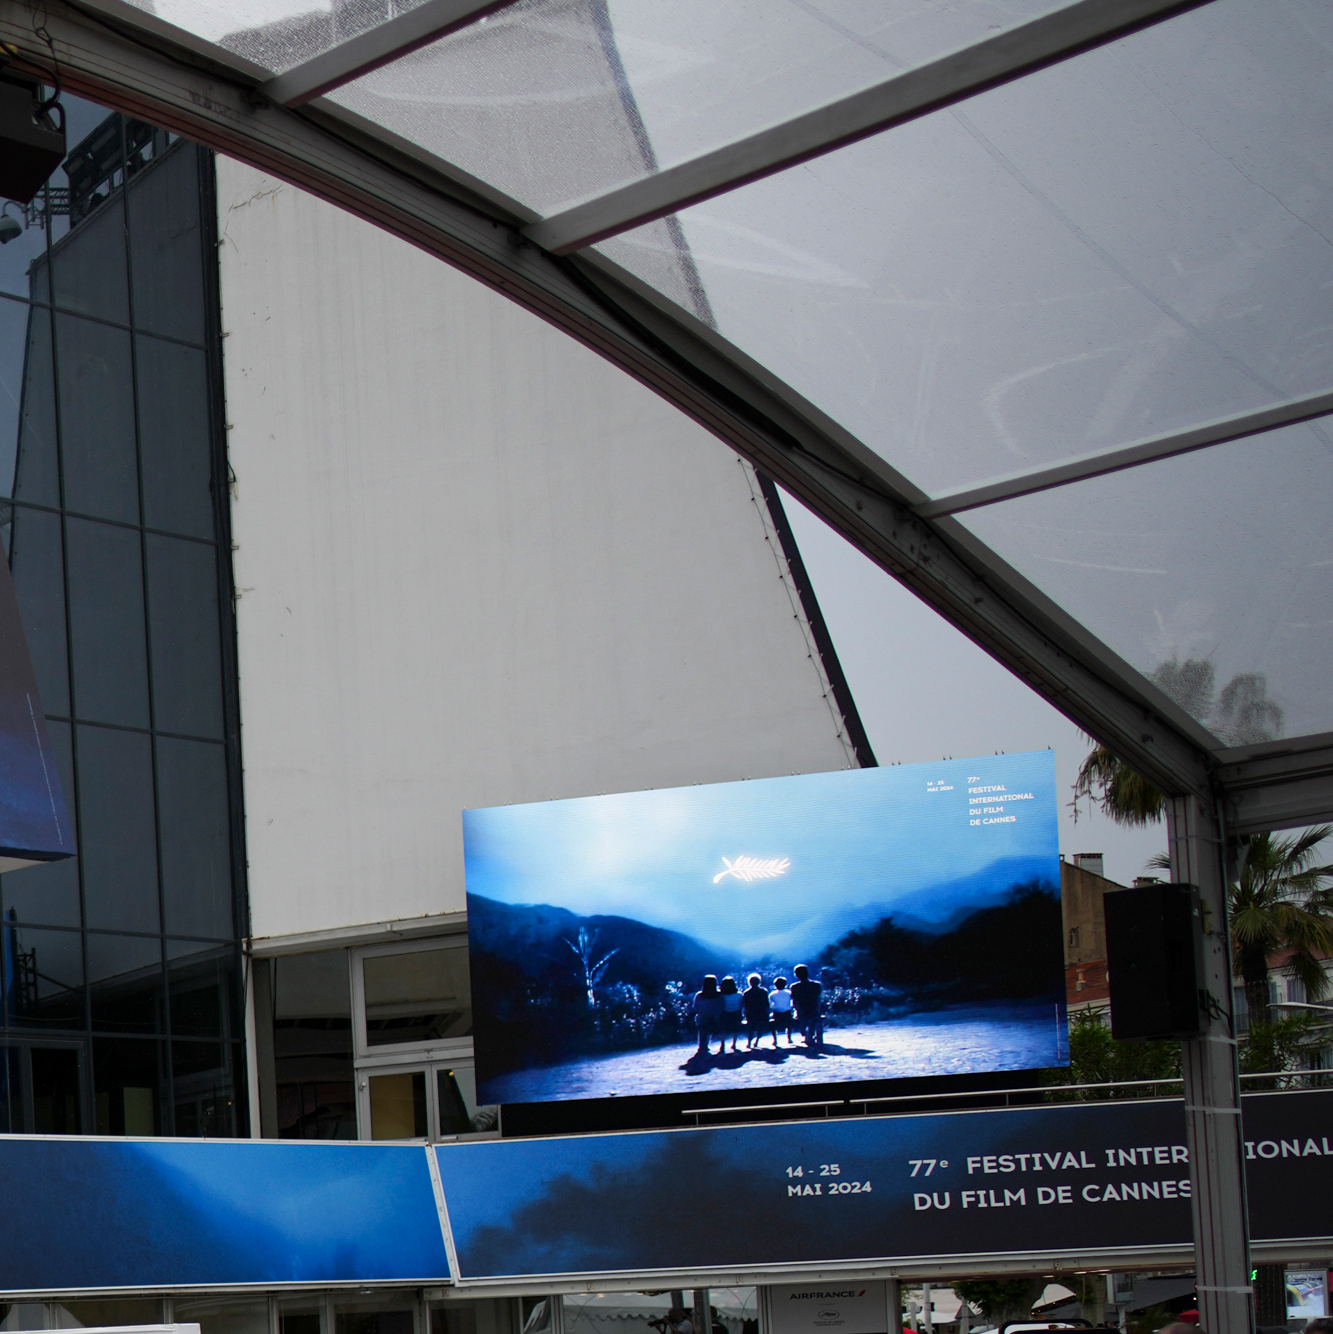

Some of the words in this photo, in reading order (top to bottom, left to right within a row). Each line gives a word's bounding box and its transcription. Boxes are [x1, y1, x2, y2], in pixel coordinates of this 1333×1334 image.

[968, 785, 1006, 794] FESTIVAL
[969, 793, 1034, 804] INTERNATIONAL
[983, 806, 1004, 814] FILM
[983, 816, 1016, 825] CANNES
[966, 1151, 1096, 1175] FESTIVAL
[1105, 1137, 1333, 1167] INTERIONAL
[785, 1165, 803, 1178] 14
[819, 1164, 840, 1177] 25
[787, 1183, 822, 1197] MAI
[828, 1181, 872, 1195] 2024
[913, 1191, 951, 1211] DU
[961, 1188, 1027, 1209] FILM
[1037, 1186, 1073, 1205] DE
[1081, 1179, 1192, 1203] CANNES
